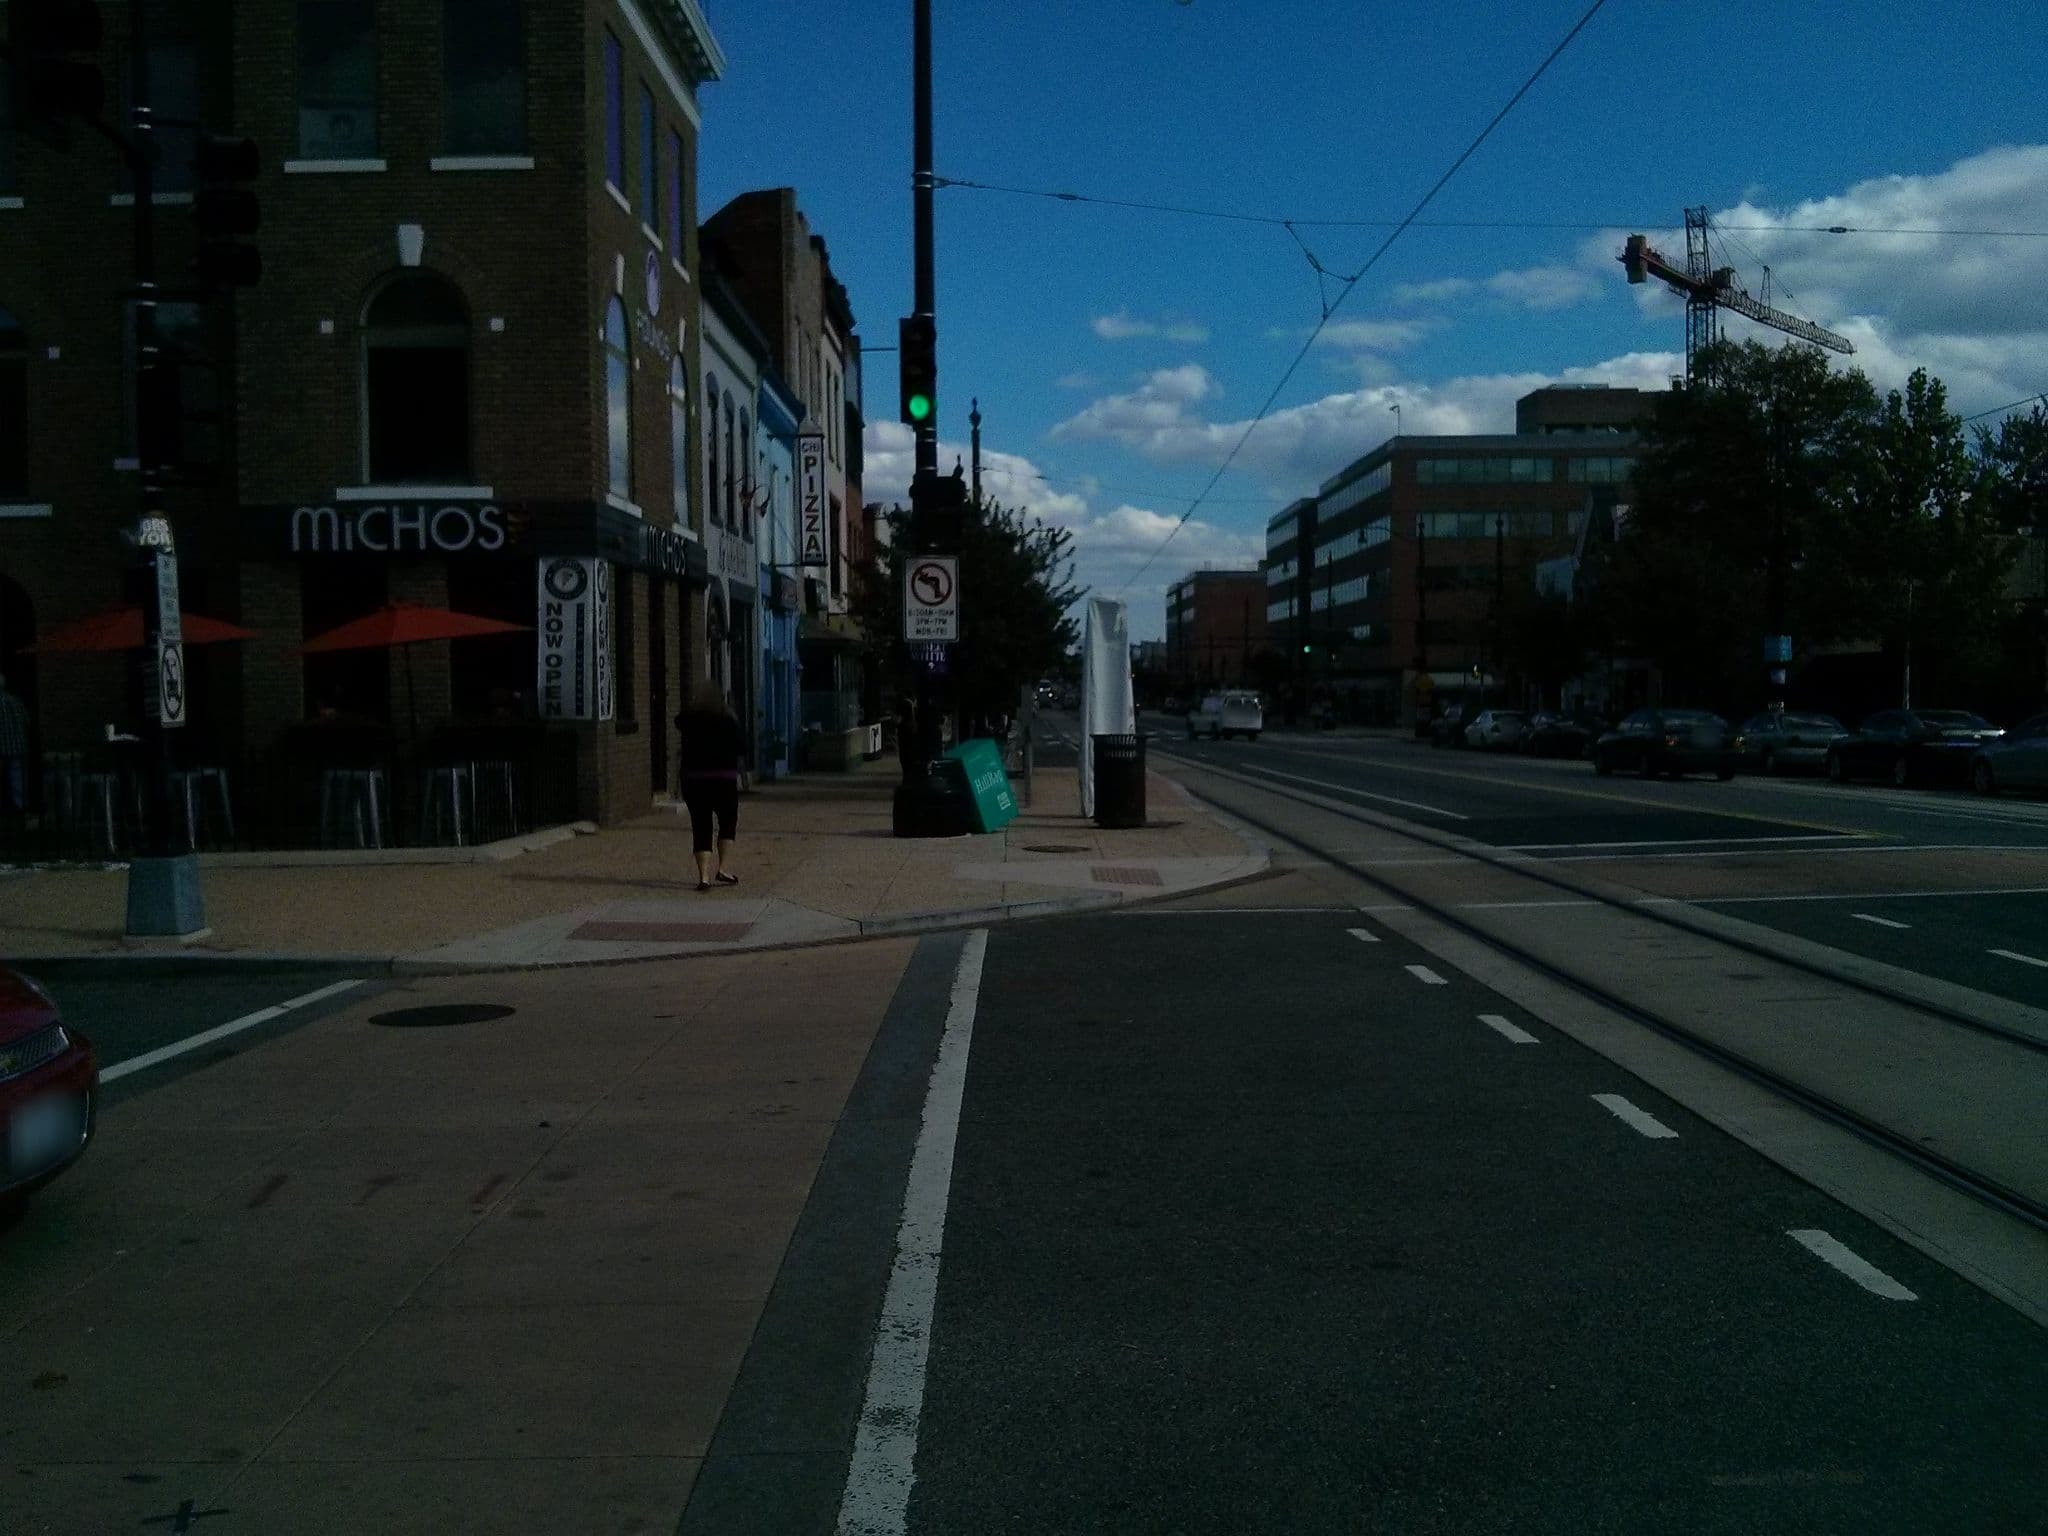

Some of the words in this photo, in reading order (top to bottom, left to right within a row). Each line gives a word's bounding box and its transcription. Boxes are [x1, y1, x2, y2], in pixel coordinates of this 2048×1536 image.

[804, 456, 820, 552] PIZZA
[545, 603, 563, 649] NOW
[545, 653, 563, 716] OPEN
